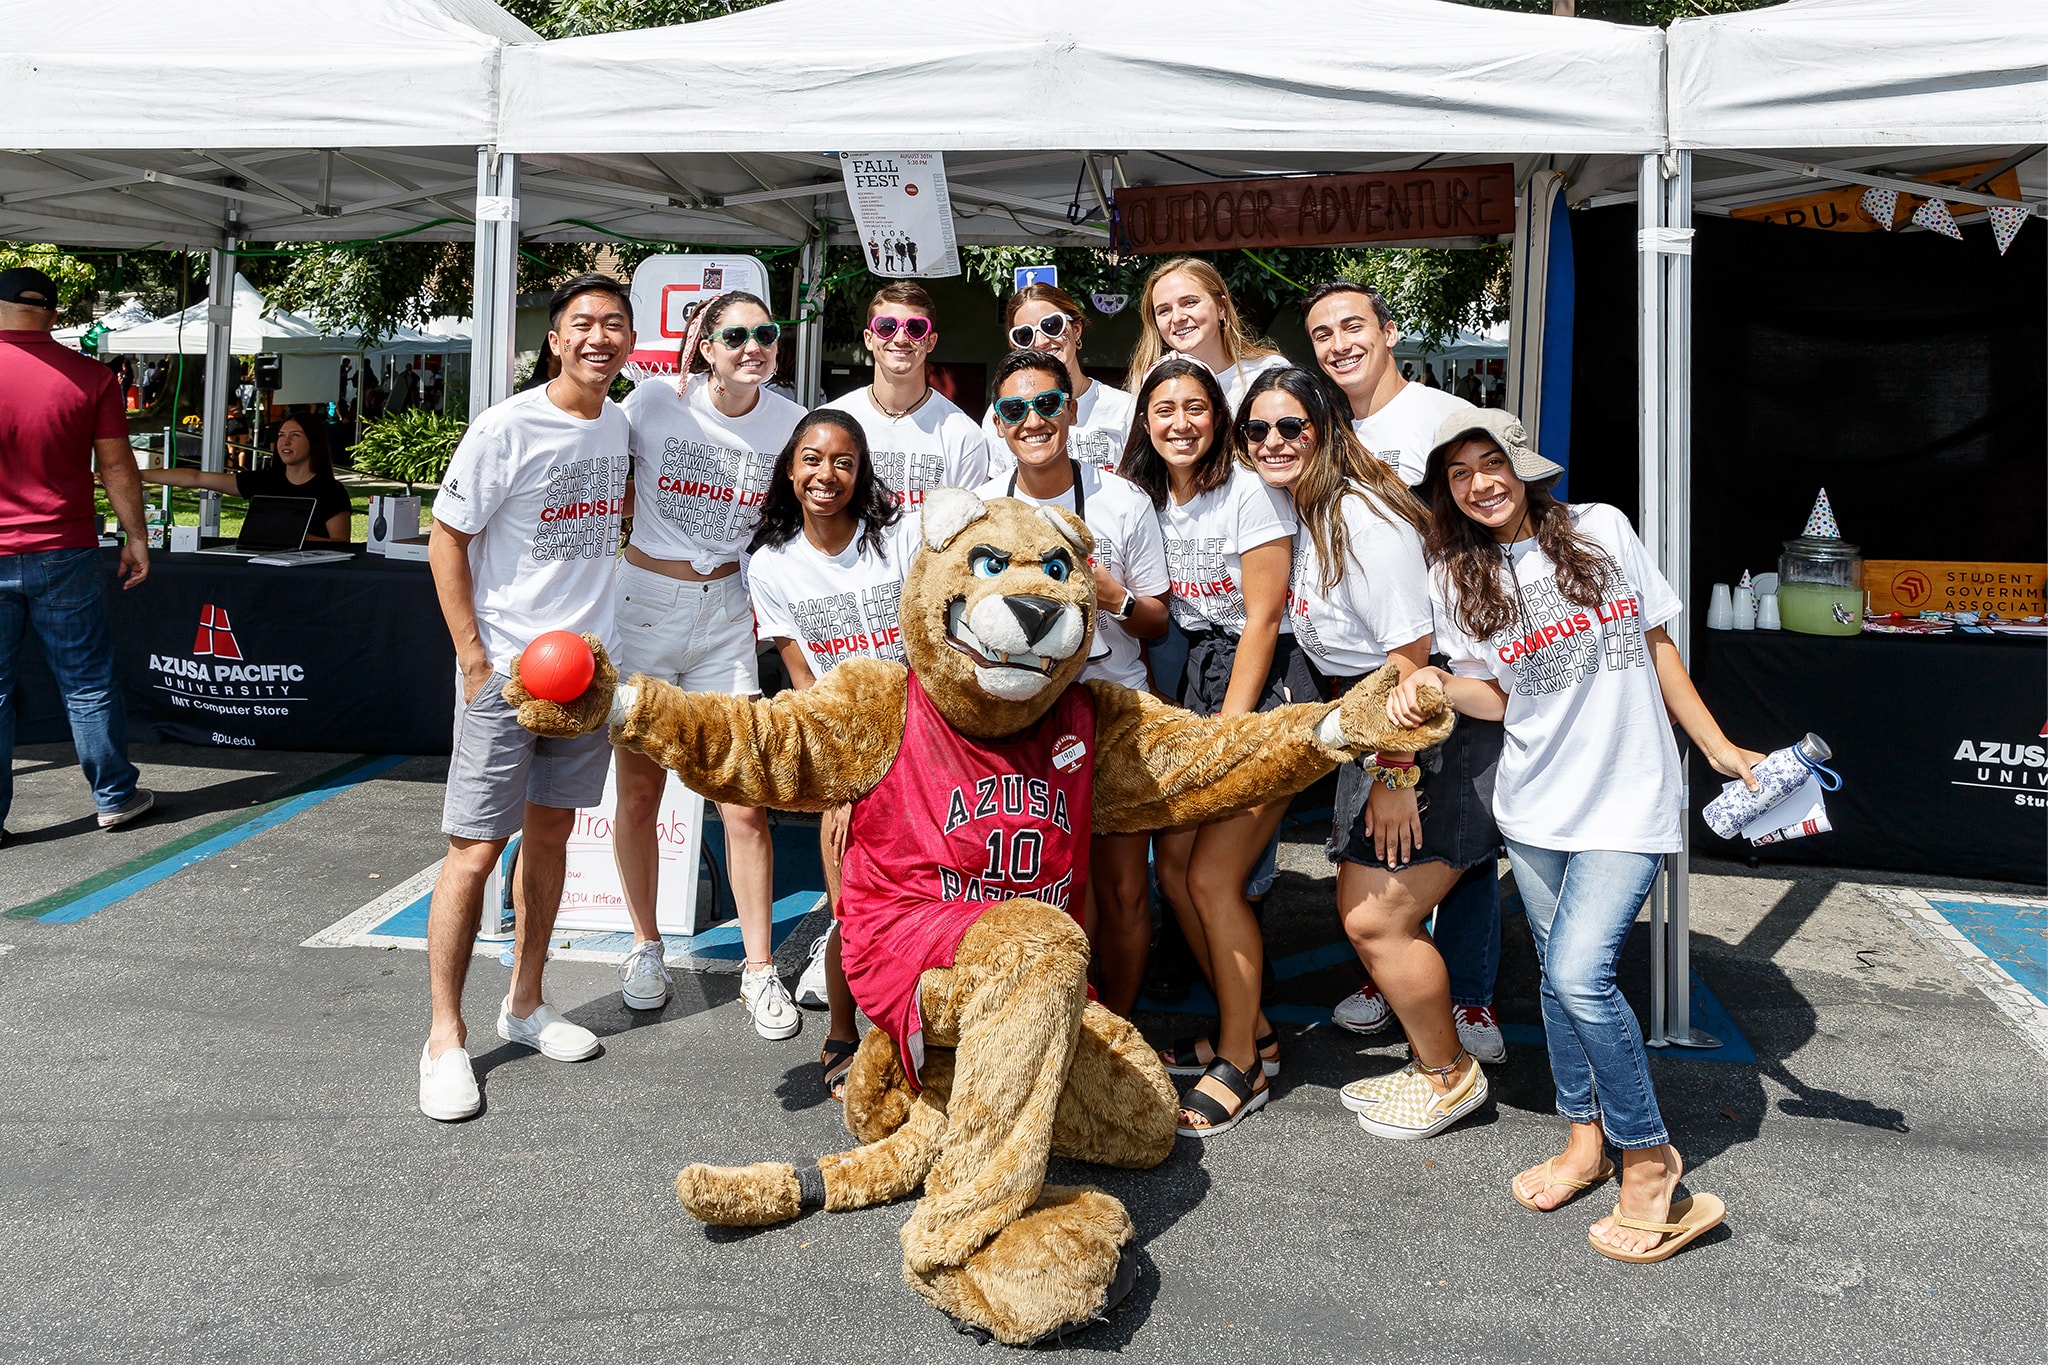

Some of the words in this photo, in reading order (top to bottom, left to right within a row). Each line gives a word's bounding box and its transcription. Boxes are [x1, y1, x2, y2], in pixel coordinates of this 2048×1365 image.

[852, 159, 899, 174] FALL
[855, 174, 900, 188] FEST
[932, 172, 948, 204] CENTER
[1128, 189, 1279, 247] OUTDOOR
[1300, 174, 1502, 236] ADVENTURE
[938, 204, 956, 250] RECREATION
[664, 437, 742, 464] CAMPUS
[870, 452, 905, 466] PUS
[548, 456, 610, 481] CAMPUS
[663, 451, 739, 478] CAMPUS
[873, 465, 905, 479] PUS
[547, 471, 609, 496] CAMPUS
[660, 464, 737, 489] CAMPUS
[658, 476, 734, 502] CAMPUS
[540, 499, 608, 522] CAMPUS
[656, 488, 731, 515] CAMPUS
[537, 514, 607, 535] CAMPUS
[677, 519, 725, 542] MPUS
[533, 528, 604, 548] CAMPUS
[531, 542, 602, 561] CAMPUS
[1170, 580, 1200, 598] PUS
[1200, 576, 1237, 597] LIFE
[1947, 572, 2034, 585] STUDENT
[788, 591, 856, 618] CAMPUS
[862, 580, 901, 605] LIFE
[867, 613, 899, 633] LIF
[1498, 613, 1591, 665] CAMPUS
[1594, 598, 1639, 625] LIFE
[1602, 616, 1641, 639] LIFE
[871, 626, 900, 648] LIF
[1604, 633, 1643, 654] LIFE
[875, 640, 904, 661] LIF
[149, 653, 212, 682] AZUSA
[214, 664, 305, 683] PACIFIC
[1515, 657, 1600, 697] CAMPUS
[1606, 650, 1646, 672] LIFE
[164, 676, 290, 696] UNIVERSITY
[171, 695, 190, 708] IMT
[193, 700, 251, 716] Computer
[253, 705, 289, 716] Store
[211, 731, 257, 747] apu.edu
[1061, 748, 1077, 762] 1901
[1953, 739, 2048, 768] AZUS
[943, 774, 1072, 837] AZUSA
[2014, 793, 2048, 808] Stu
[982, 828, 1044, 883] 10
